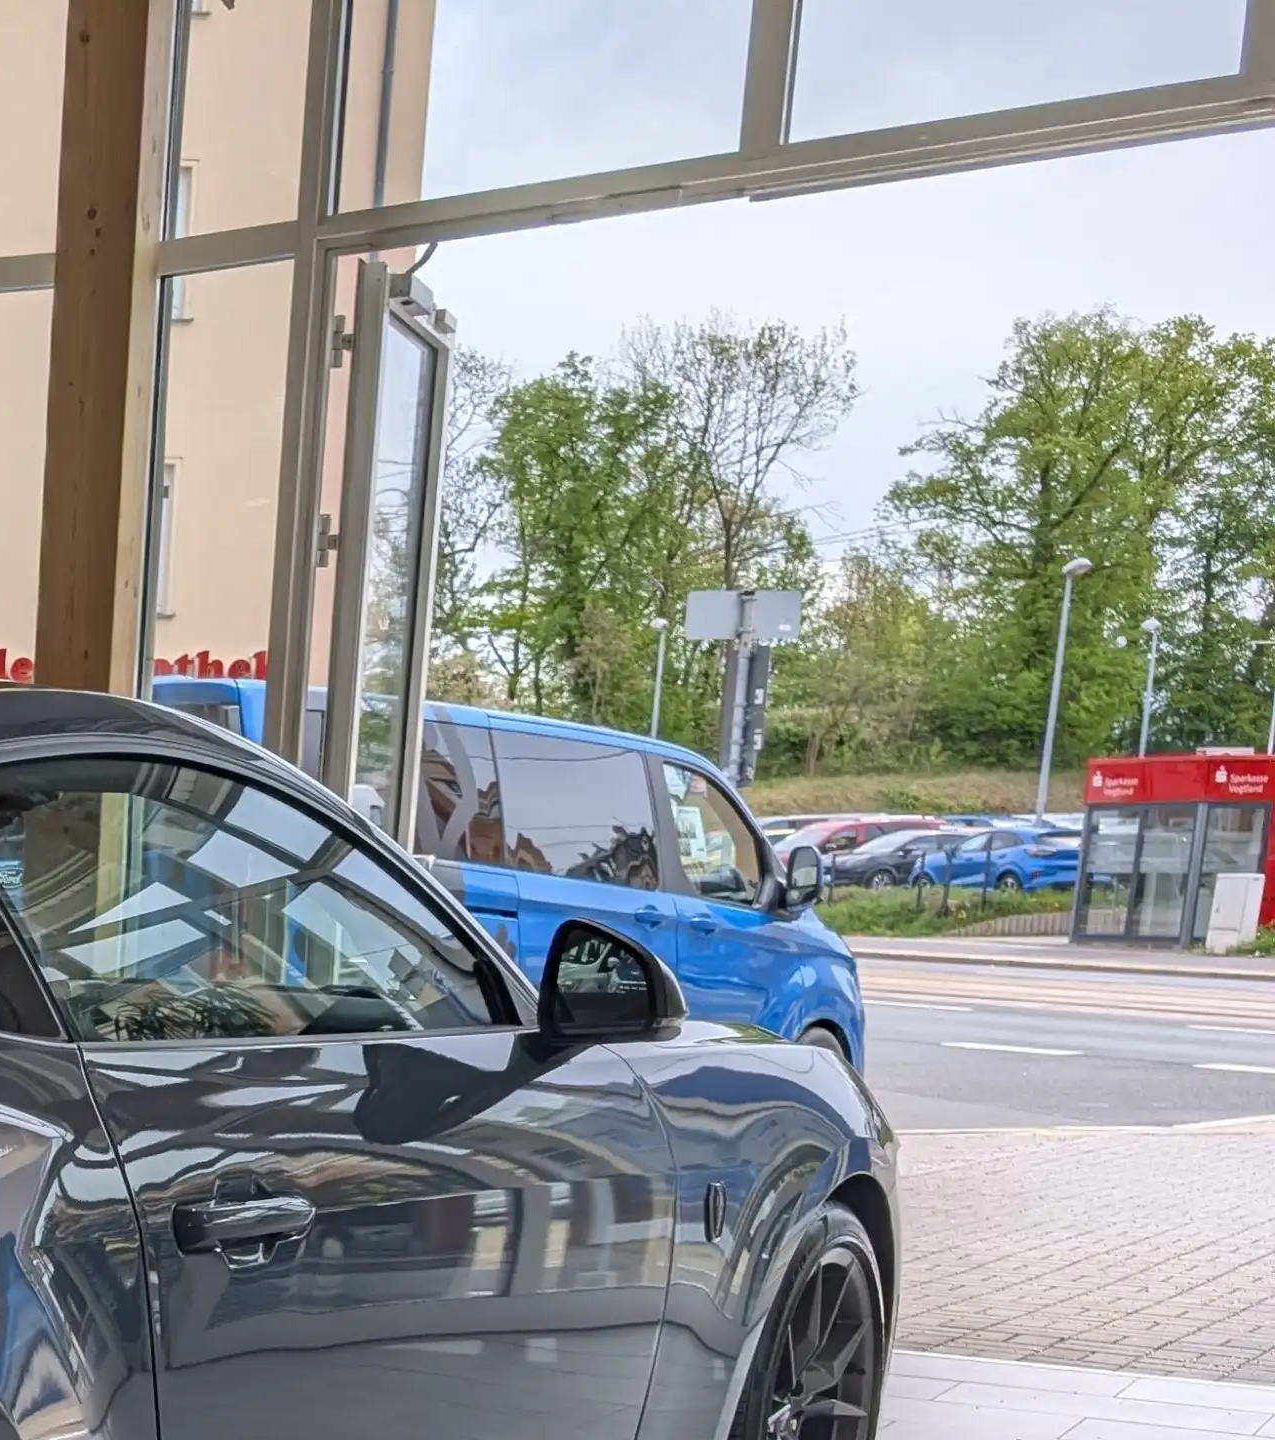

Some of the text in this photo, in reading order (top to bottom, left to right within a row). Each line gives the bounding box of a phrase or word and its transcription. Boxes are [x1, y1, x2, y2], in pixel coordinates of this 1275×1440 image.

[1104, 776, 1139, 787] Sparkasse
[1229, 773, 1269, 785] Sparkasse
[1103, 786, 1135, 797] Vogtland
[1228, 784, 1264, 795] Vogtland
